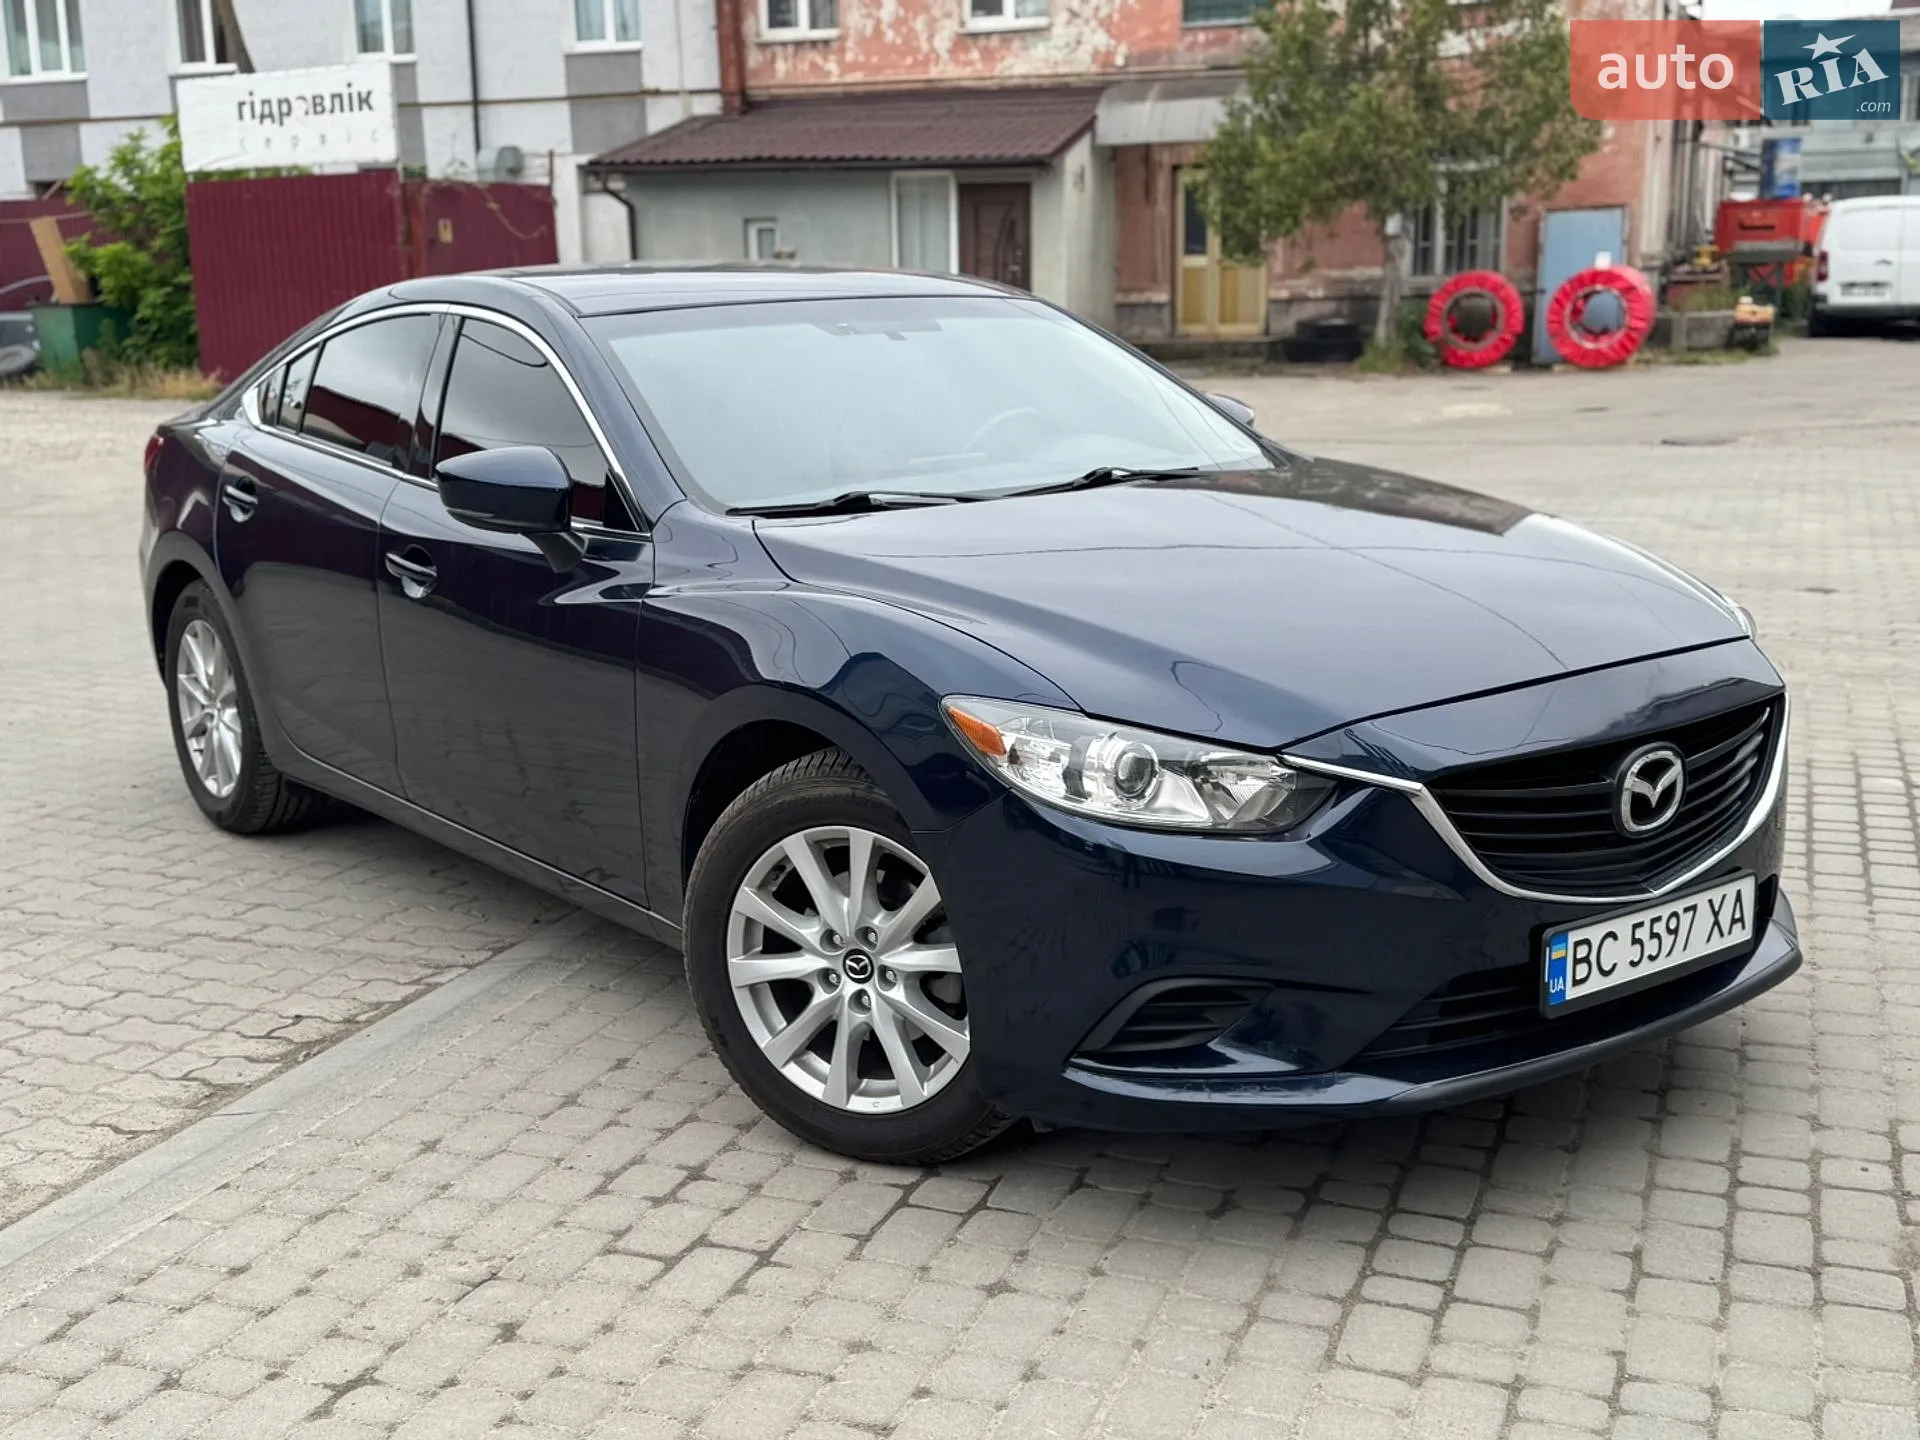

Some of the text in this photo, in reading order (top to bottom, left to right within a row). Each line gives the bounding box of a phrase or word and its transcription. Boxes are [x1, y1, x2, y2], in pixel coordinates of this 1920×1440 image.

[1571, 888, 1747, 988] BC 5597 XA
[1549, 978, 1565, 994] UA
